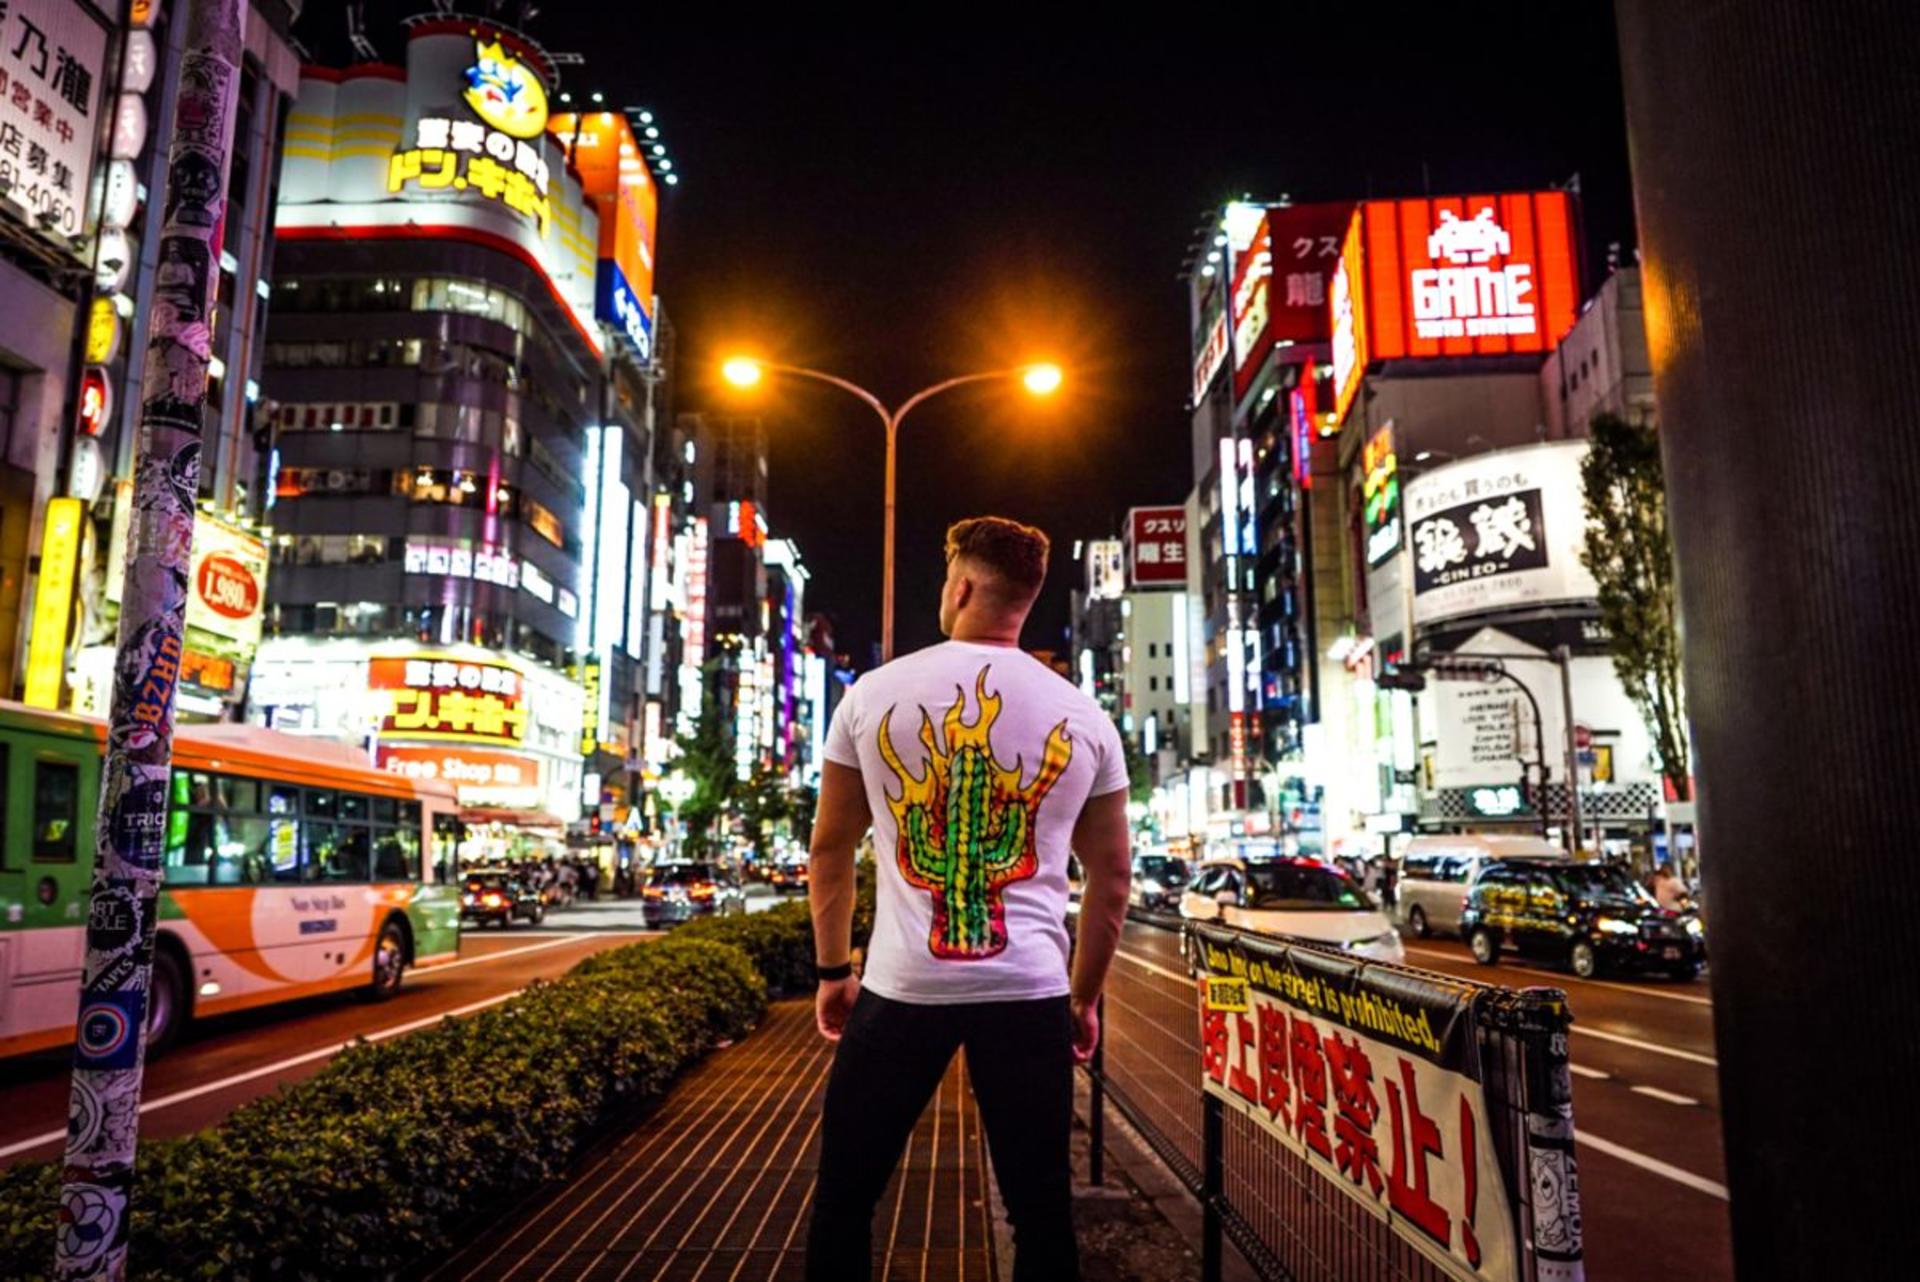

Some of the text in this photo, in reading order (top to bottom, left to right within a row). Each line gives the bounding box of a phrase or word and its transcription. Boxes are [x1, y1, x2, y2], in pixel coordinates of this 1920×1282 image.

[0, 3, 92, 118] 乃瀧
[1412, 264, 1534, 320] GAME
[386, 757, 437, 778] Free
[442, 759, 492, 784] Shop
[1340, 988, 1441, 1053] prohibited.
